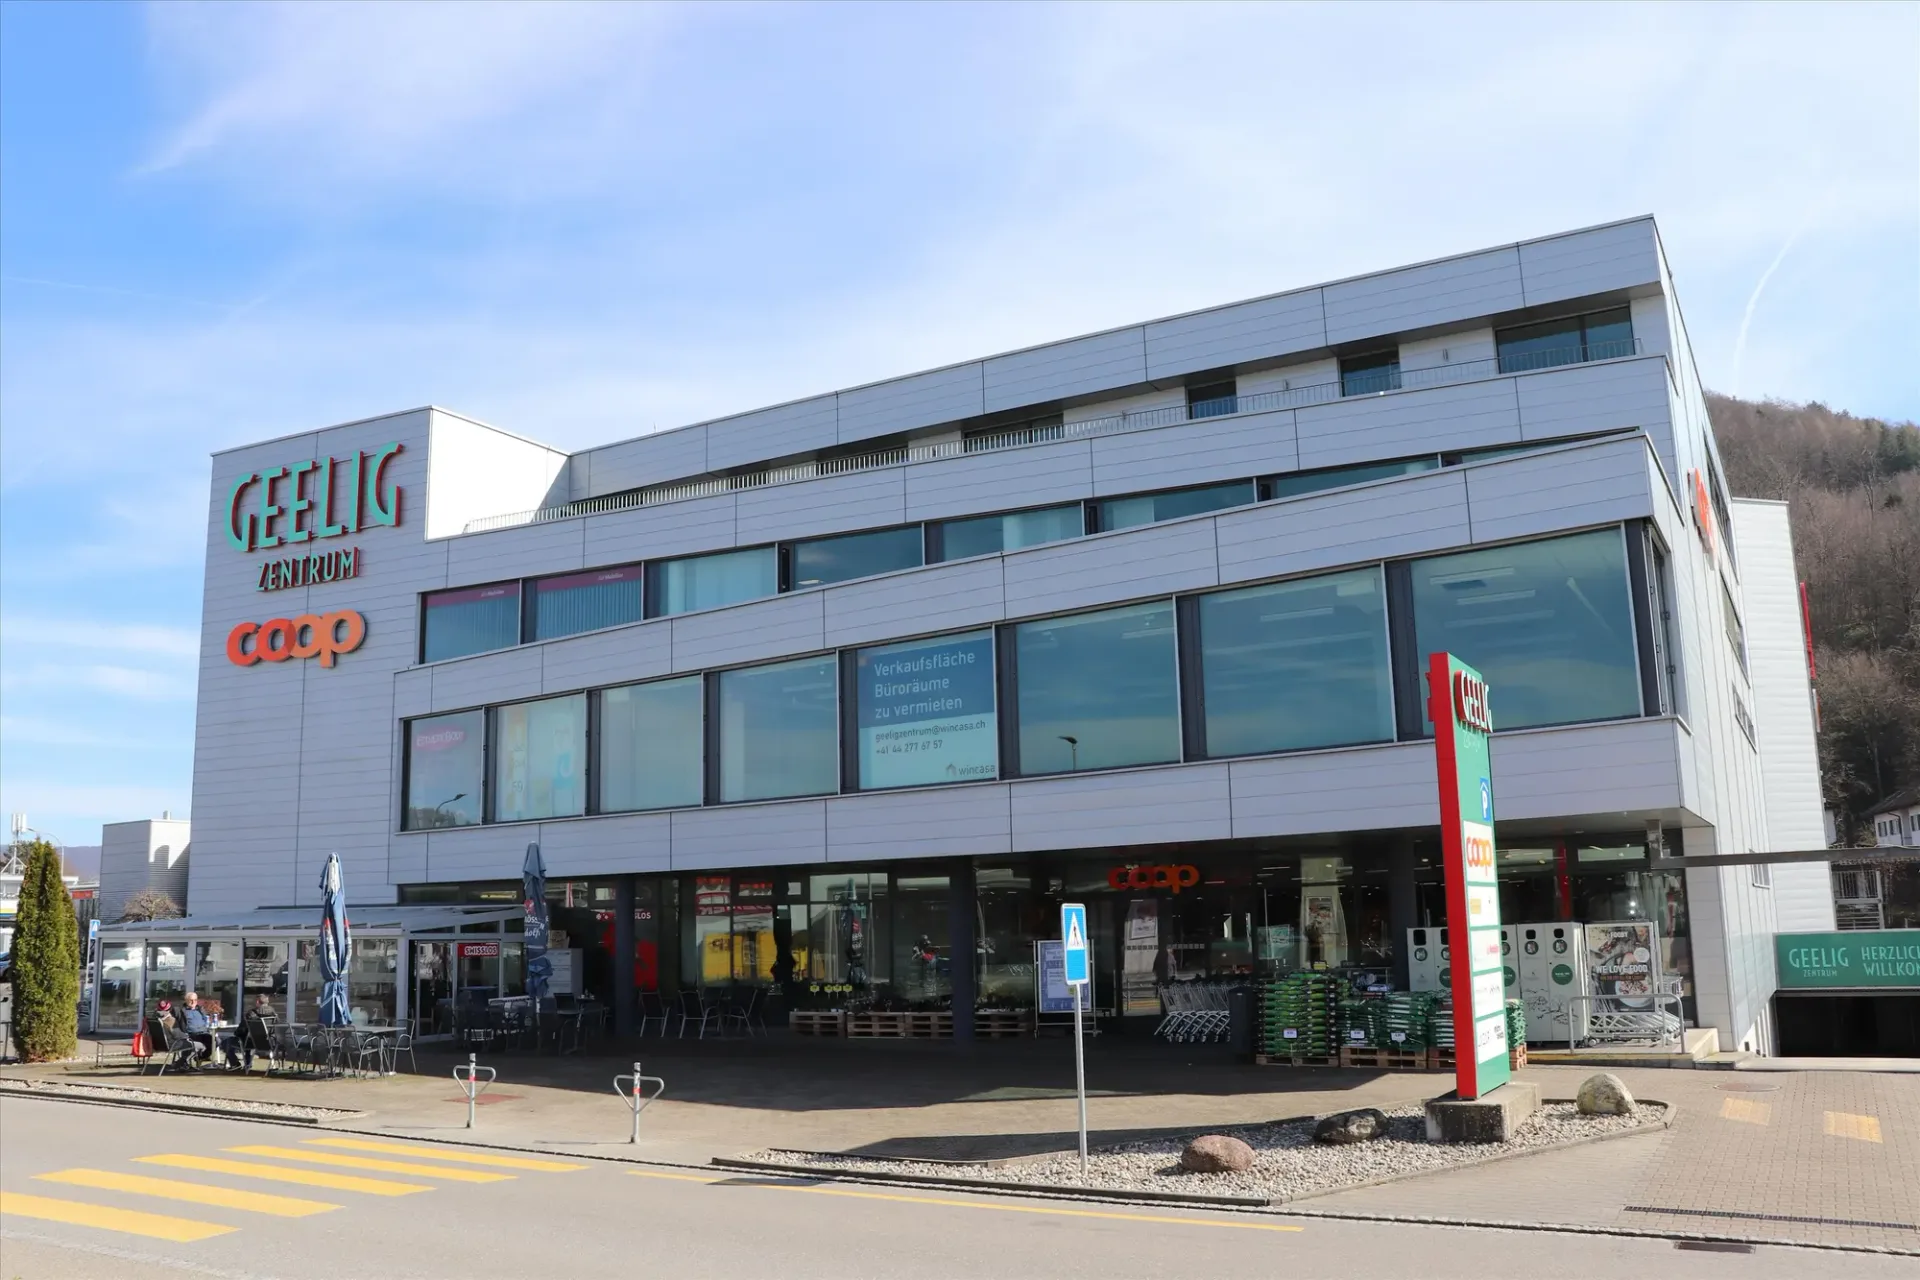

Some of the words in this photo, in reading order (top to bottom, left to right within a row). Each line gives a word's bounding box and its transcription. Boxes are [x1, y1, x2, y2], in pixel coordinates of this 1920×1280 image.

[224, 441, 403, 552] GEELIG
[256, 547, 360, 592] ZENTRUM
[226, 609, 366, 668] coop
[874, 651, 976, 677] Verkaufsfläche
[875, 678, 950, 698] Büroräume
[875, 707, 890, 719] zu
[894, 697, 962, 717] vermieten
[875, 720, 986, 742] geeligzentrum@wincasa.ch
[876, 744, 889, 754] +41
[933, 740, 943, 749] 57
[958, 764, 996, 776] wincasa
[1466, 835, 1492, 877] coop
[1108, 864, 1199, 893] coop
[464, 945, 497, 956] SWISSLOS
[1788, 947, 1849, 968] GEELIG
[1629, 964, 1648, 973] FOOD
[1803, 969, 1838, 977] ZENTRUM
